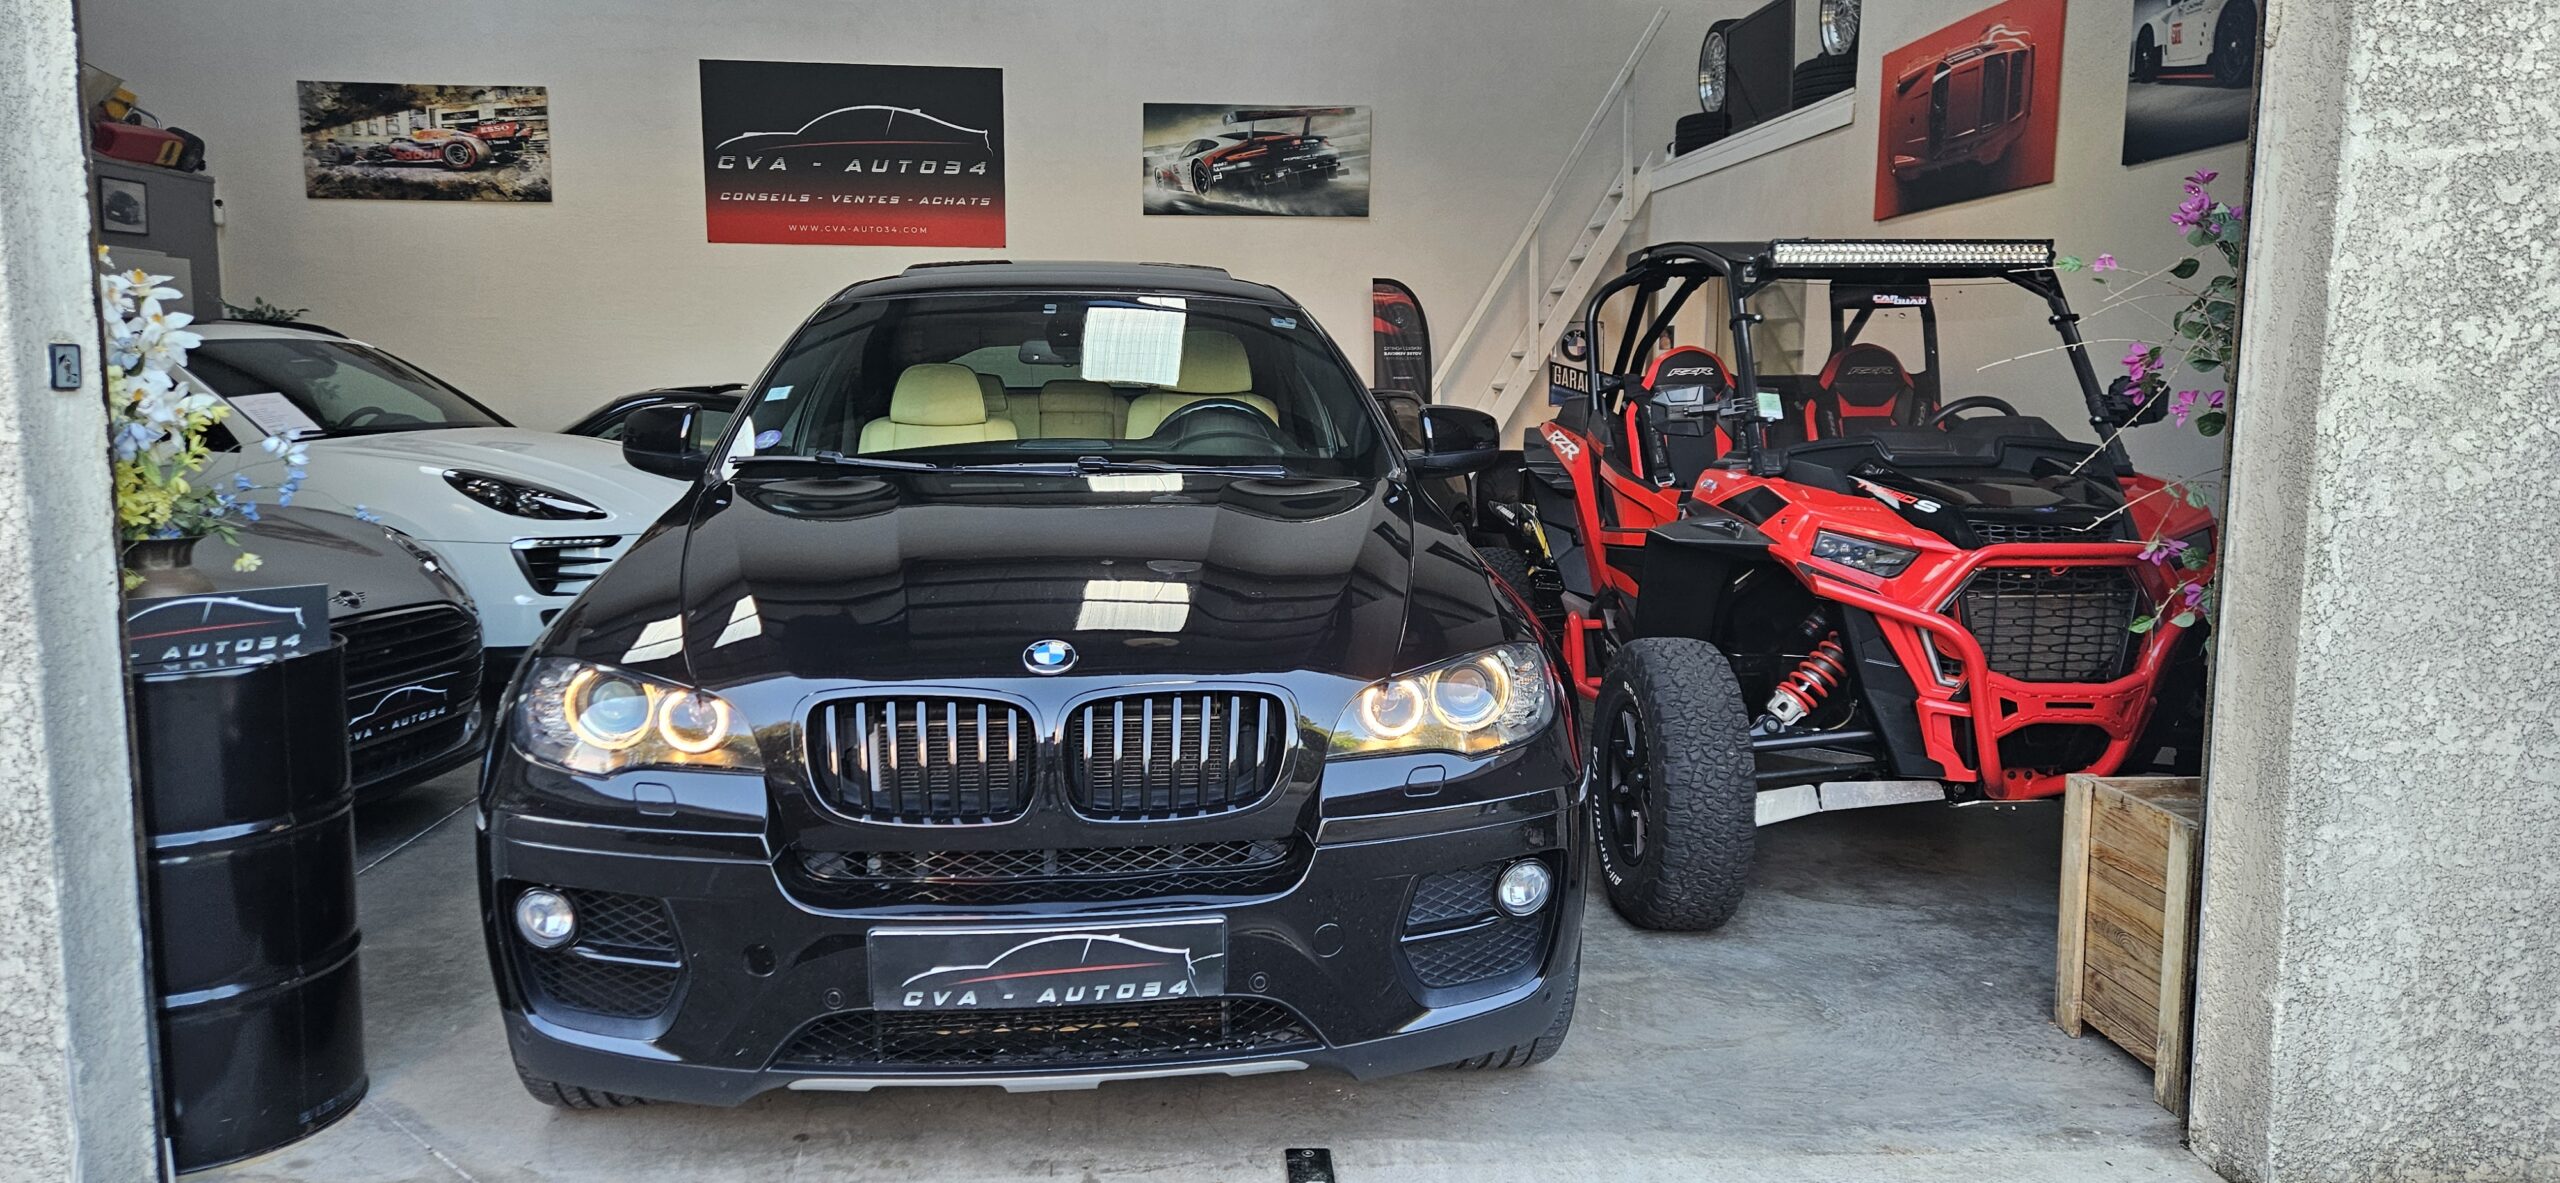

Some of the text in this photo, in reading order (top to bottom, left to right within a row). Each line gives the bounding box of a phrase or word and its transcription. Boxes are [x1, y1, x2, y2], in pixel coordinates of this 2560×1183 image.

[481, 124, 511, 134] ESSO
[717, 155, 787, 171] CVA
[844, 158, 987, 175] AUTO34
[720, 191, 810, 203] CONSEILS
[832, 194, 901, 204] VENTES
[919, 196, 992, 206] ACHATS
[788, 224, 928, 234] WWW.CVA-AUTO34.COM
[1553, 364, 1589, 393] GARA
[1667, 366, 1714, 377] RZR
[1546, 429, 1580, 461] RZR
[1913, 499, 1942, 514] S
[162, 633, 302, 661] AUTO34
[391, 706, 447, 730] AUTO34
[903, 990, 977, 1007] CVA
[1037, 979, 1188, 1003] AUTO34
